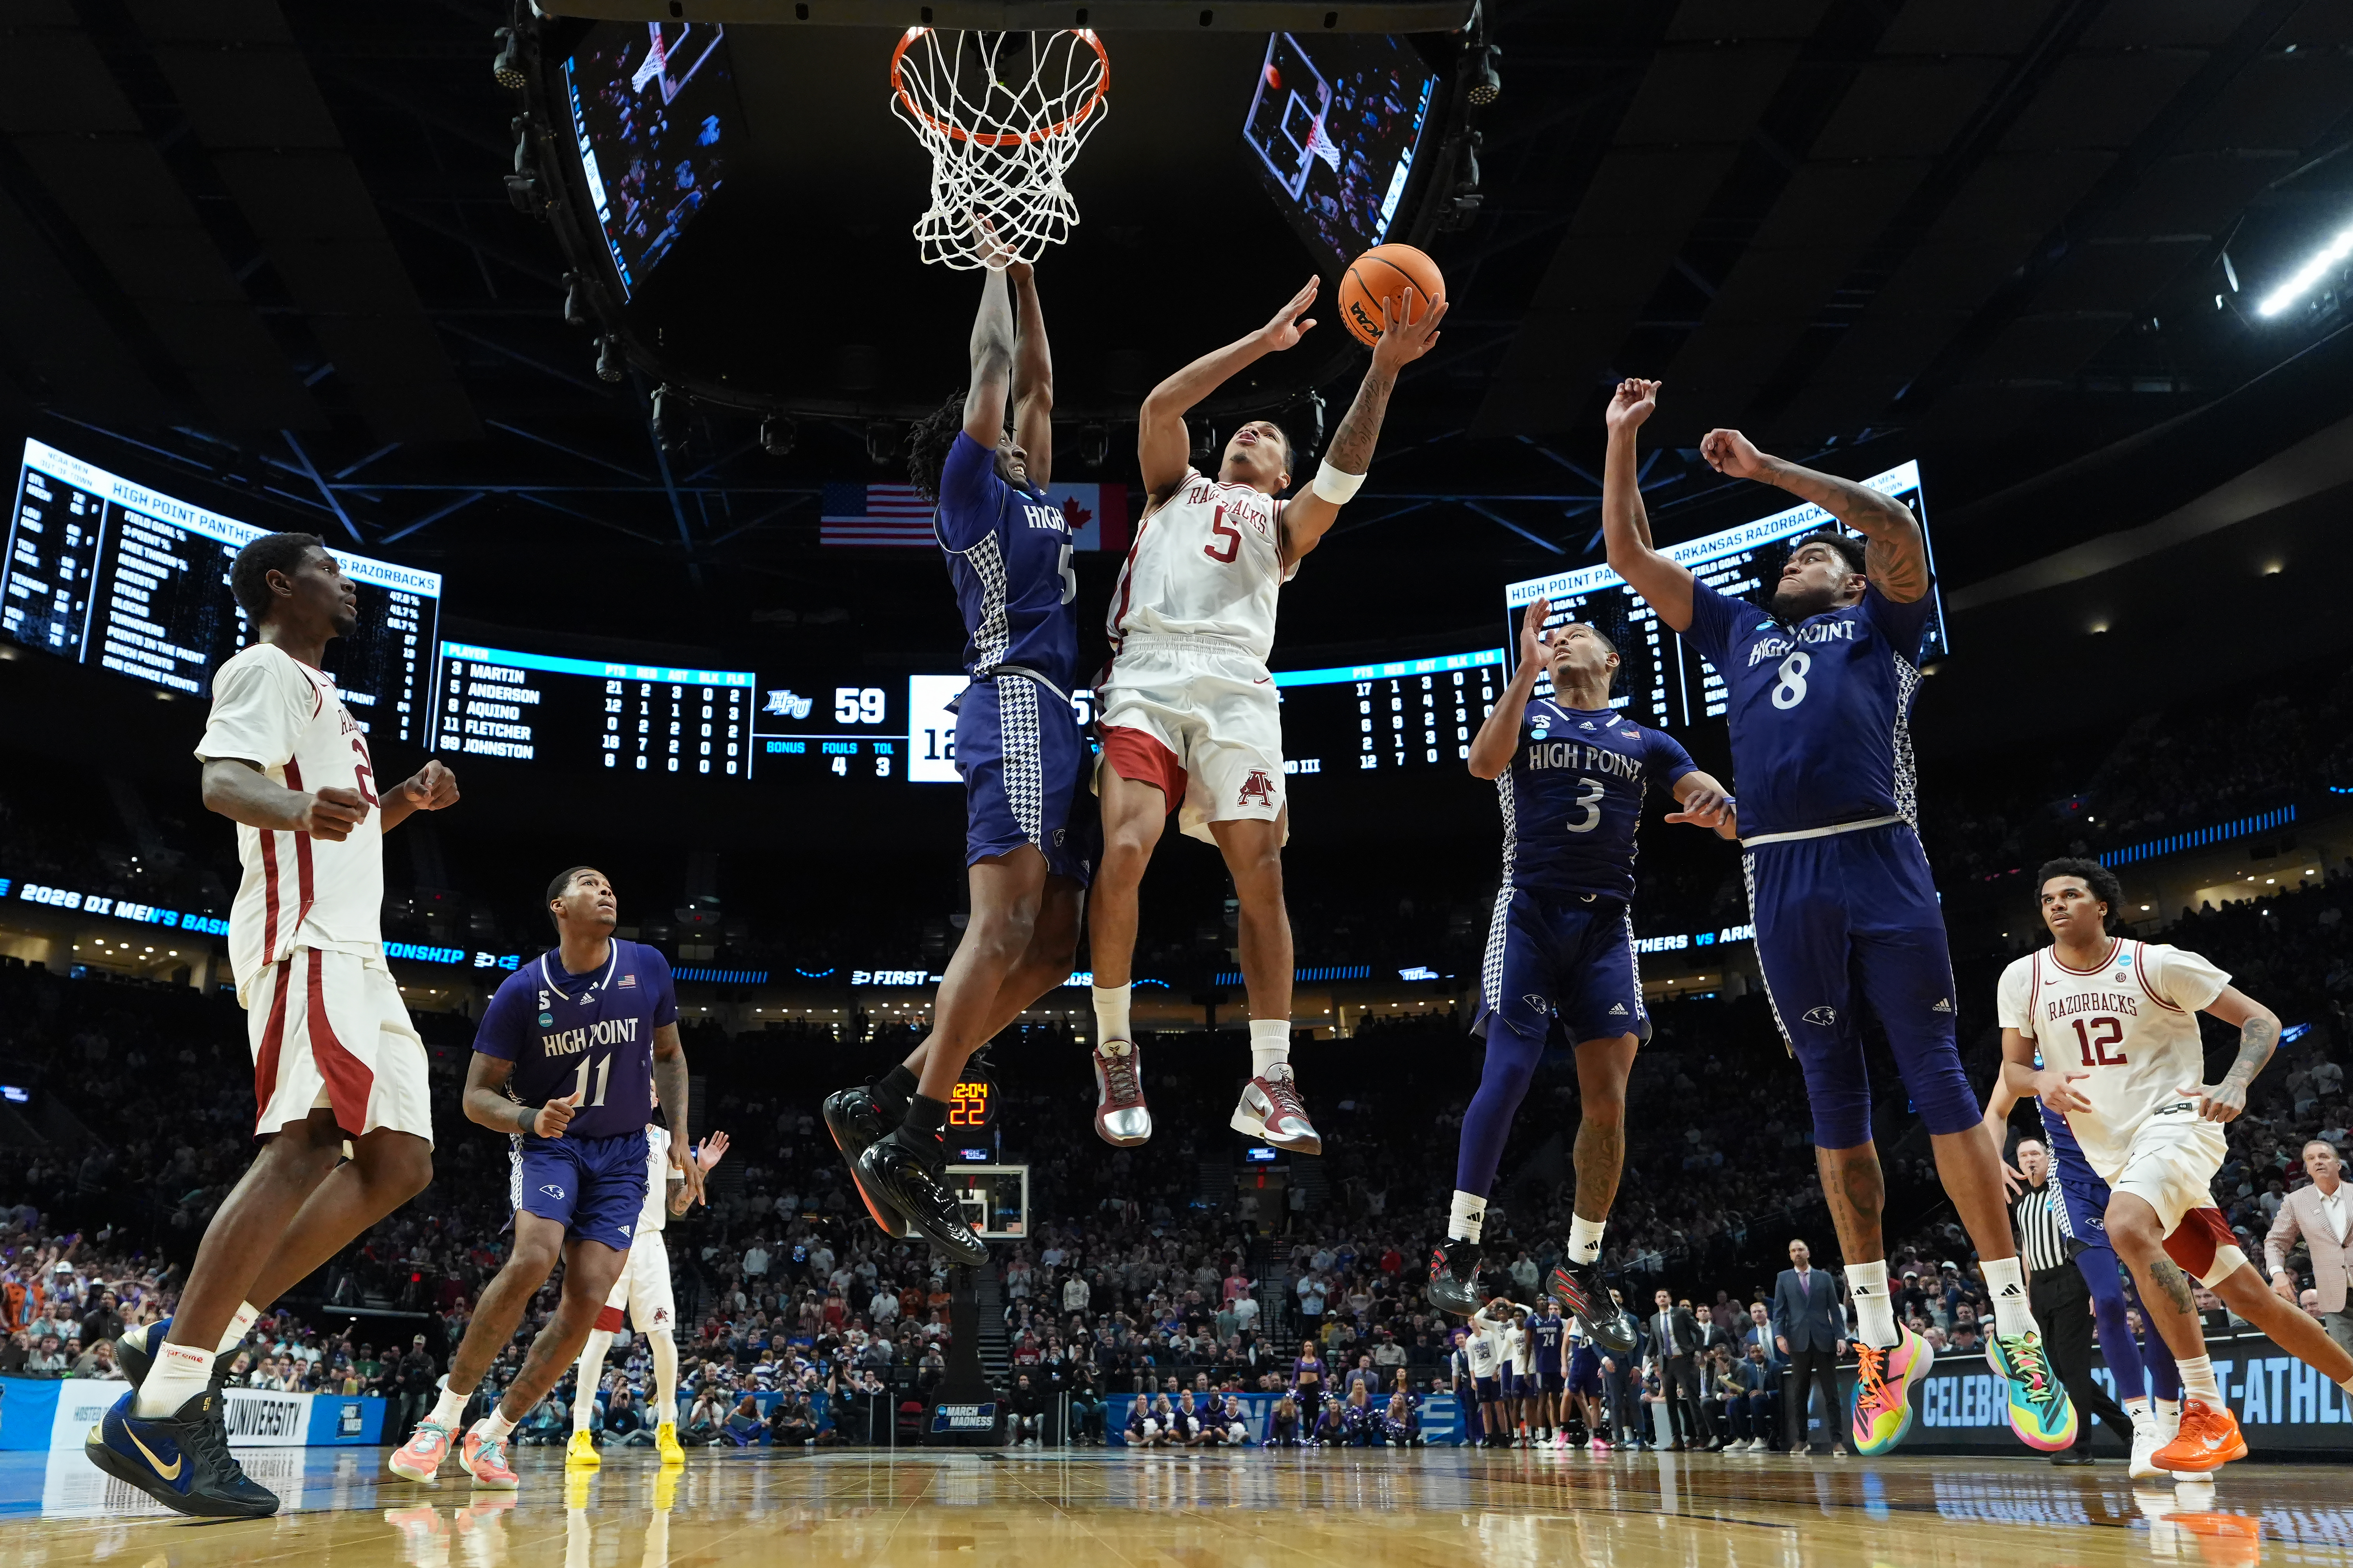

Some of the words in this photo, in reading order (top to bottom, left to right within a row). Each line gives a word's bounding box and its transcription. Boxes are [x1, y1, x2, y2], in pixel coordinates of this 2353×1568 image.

[586, 157, 596, 180] 12:04
[1384, 191, 1396, 215] 12:04
[40, 459, 55, 471] OUT
[58, 467, 67, 475] OF
[70, 472, 93, 487] TOWN
[47, 452, 68, 466] NCAA
[71, 462, 88, 474] MEN
[113, 482, 149, 507] HIGH
[153, 496, 195, 524] POINT
[124, 510, 152, 529] FIELD
[152, 520, 176, 538] GOAL
[1023, 505, 1065, 533] HIGH
[1204, 506, 1241, 563] 5
[1674, 533, 1742, 562] ARKANSAS
[118, 553, 169, 579] REBOUNDS
[120, 538, 144, 556] FREE
[144, 547, 178, 568] THROW
[1718, 557, 1741, 570] GOAL
[115, 568, 158, 590] ASSISTS
[351, 560, 434, 589] RAZORBACKS
[1512, 584, 1544, 600] HIGH
[1550, 573, 1590, 592] POINT
[114, 582, 150, 602] STEALS
[111, 596, 150, 618] BLOCKS
[110, 611, 166, 638] TURNOVERS
[105, 640, 138, 660] BENCH
[138, 650, 175, 671] POINTS
[107, 626, 144, 646] POINTS
[144, 637, 157, 651] IN
[157, 641, 177, 656] THE
[176, 647, 207, 664] PAINT
[1748, 638, 1795, 667] HIGH
[102, 655, 124, 671] 2ND
[124, 662, 162, 682] CHANCE
[162, 673, 199, 693] POINTS
[449, 645, 488, 660] PLAYER
[605, 665, 626, 677] PTS
[668, 670, 688, 682] AST
[727, 673, 745, 685] FLS
[452, 661, 461, 675] 3
[470, 664, 525, 684] MARTIN
[606, 680, 622, 694] 21
[641, 684, 650, 696] 2
[672, 686, 681, 699] 3
[703, 688, 713, 700] 0
[730, 689, 739, 702] 2
[1772, 651, 1810, 709] 8
[347, 693, 376, 706] PAINT
[450, 680, 460, 693] 5
[468, 683, 540, 705] ANDERSON
[605, 699, 621, 712] 12
[641, 701, 648, 714] 1
[672, 704, 679, 716] 1
[702, 706, 712, 718] 0
[729, 707, 738, 720] 3
[835, 688, 885, 724] 59
[448, 699, 459, 712] 8
[466, 701, 520, 721] AQUINO
[608, 717, 617, 730] 0
[639, 720, 648, 732] 2
[670, 722, 679, 735] 2
[701, 724, 711, 736] 0
[728, 725, 738, 738] 2
[444, 717, 459, 731] 11
[465, 719, 532, 741] FLETCHER
[603, 735, 619, 748] 16
[639, 738, 647, 750] 7
[669, 740, 678, 753] 2
[701, 742, 710, 754] 0
[728, 743, 737, 756] 0
[767, 742, 805, 753] BONUS
[822, 742, 857, 754] FOULS
[873, 743, 894, 755] TOL
[441, 735, 460, 750] 99
[463, 739, 534, 760] JOHNSTON
[605, 753, 615, 766] 6
[637, 756, 646, 769] 0
[668, 758, 678, 771] 0
[699, 760, 709, 773] 0
[727, 761, 736, 774] 0
[831, 757, 847, 776] 4
[876, 757, 890, 777] 3
[1530, 743, 1577, 770] HIGH
[1585, 747, 1643, 782] POINT
[1566, 778, 1604, 832] 3
[20, 884, 82, 909] 2026
[84, 895, 113, 915] DI
[114, 901, 179, 926] MEN'S
[1696, 933, 1715, 946] VS
[873, 971, 927, 984] FIRST
[2048, 992, 2137, 1022] RAZORBACKS
[542, 1028, 586, 1057] HIGH
[589, 1018, 638, 1047] POINT
[2072, 1017, 2127, 1066] 12
[571, 1052, 611, 1107] 11
[953, 1083, 987, 1098] 12:04
[950, 1099, 985, 1125] 22
[160, 1344, 203, 1363] Supreme
[1543, 1334, 1555, 1347] 24
[228, 1398, 301, 1437] UNIVERSITY
[946, 1406, 979, 1416] MARCH
[950, 1417, 993, 1426] MADNESS
